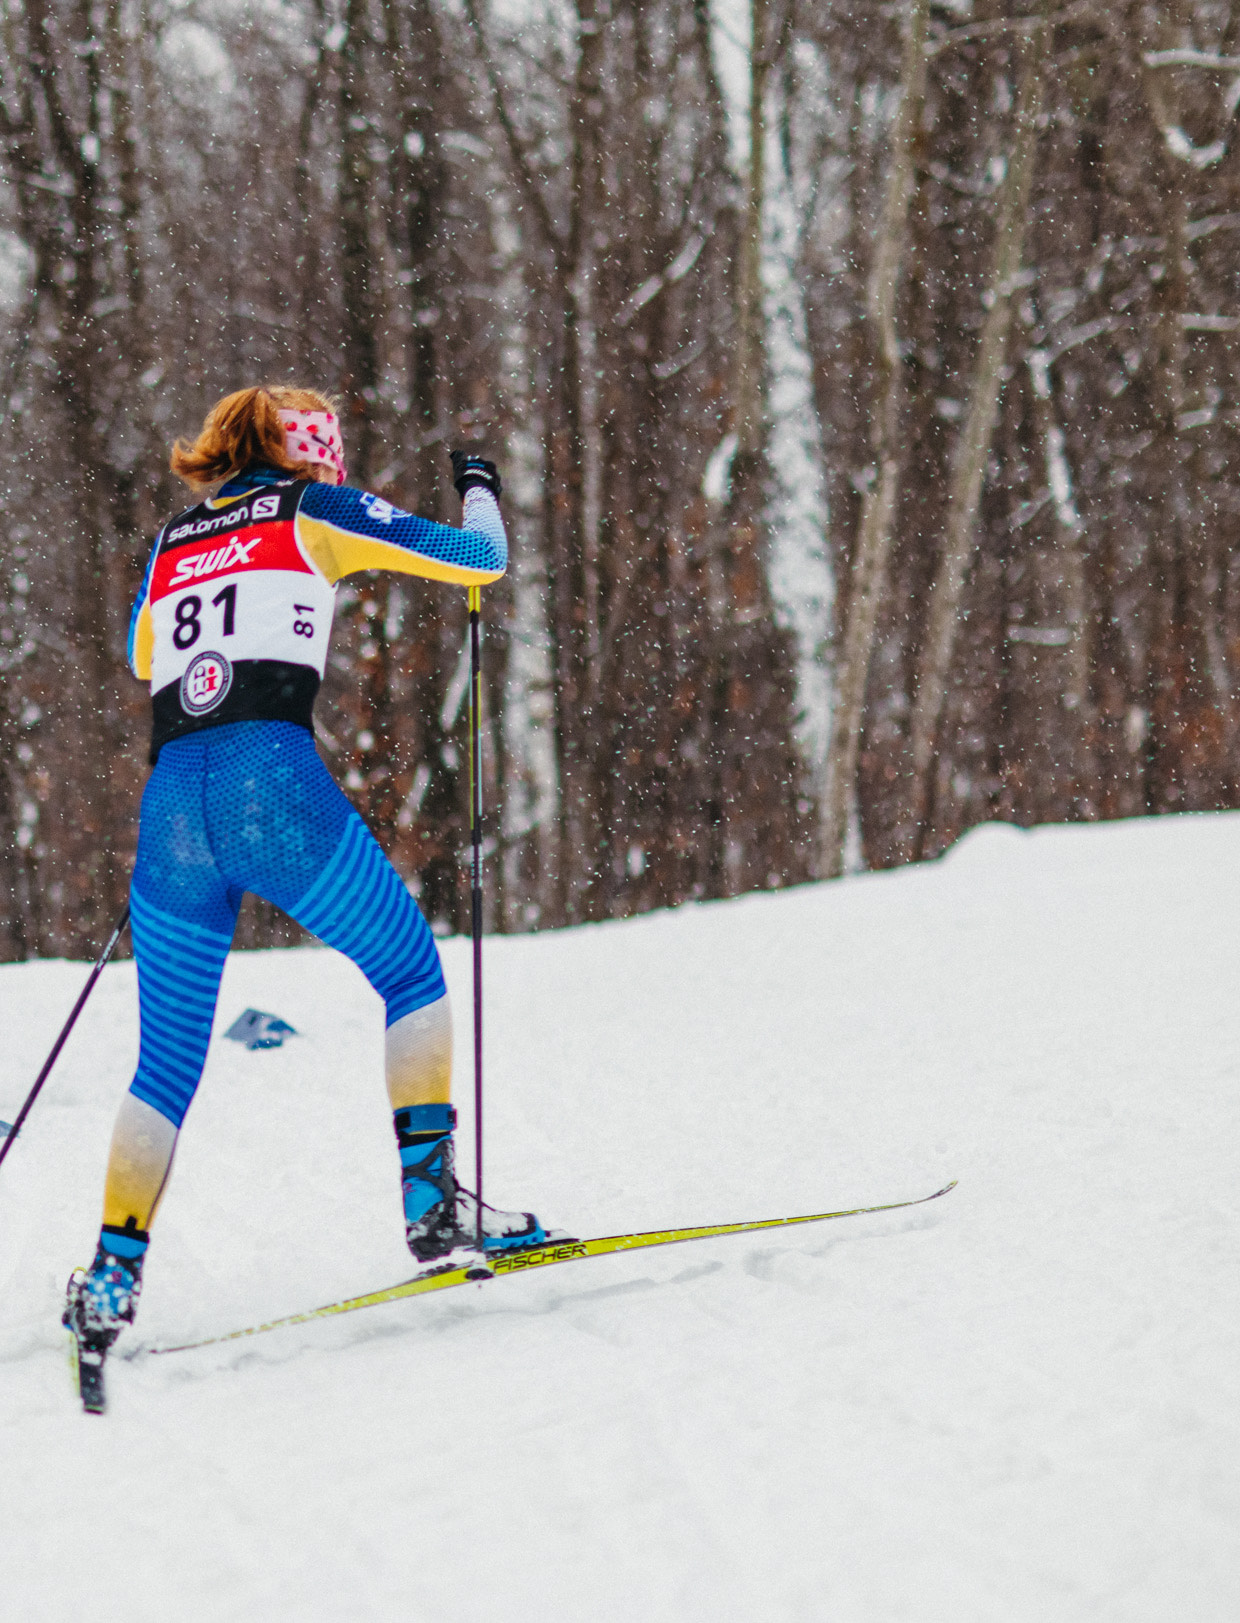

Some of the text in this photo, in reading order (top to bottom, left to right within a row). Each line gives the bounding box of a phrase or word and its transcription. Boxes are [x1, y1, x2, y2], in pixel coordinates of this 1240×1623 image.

[172, 583, 237, 651] 81
[293, 603, 315, 639] 81
[493, 1243, 588, 1274] FISCHER
